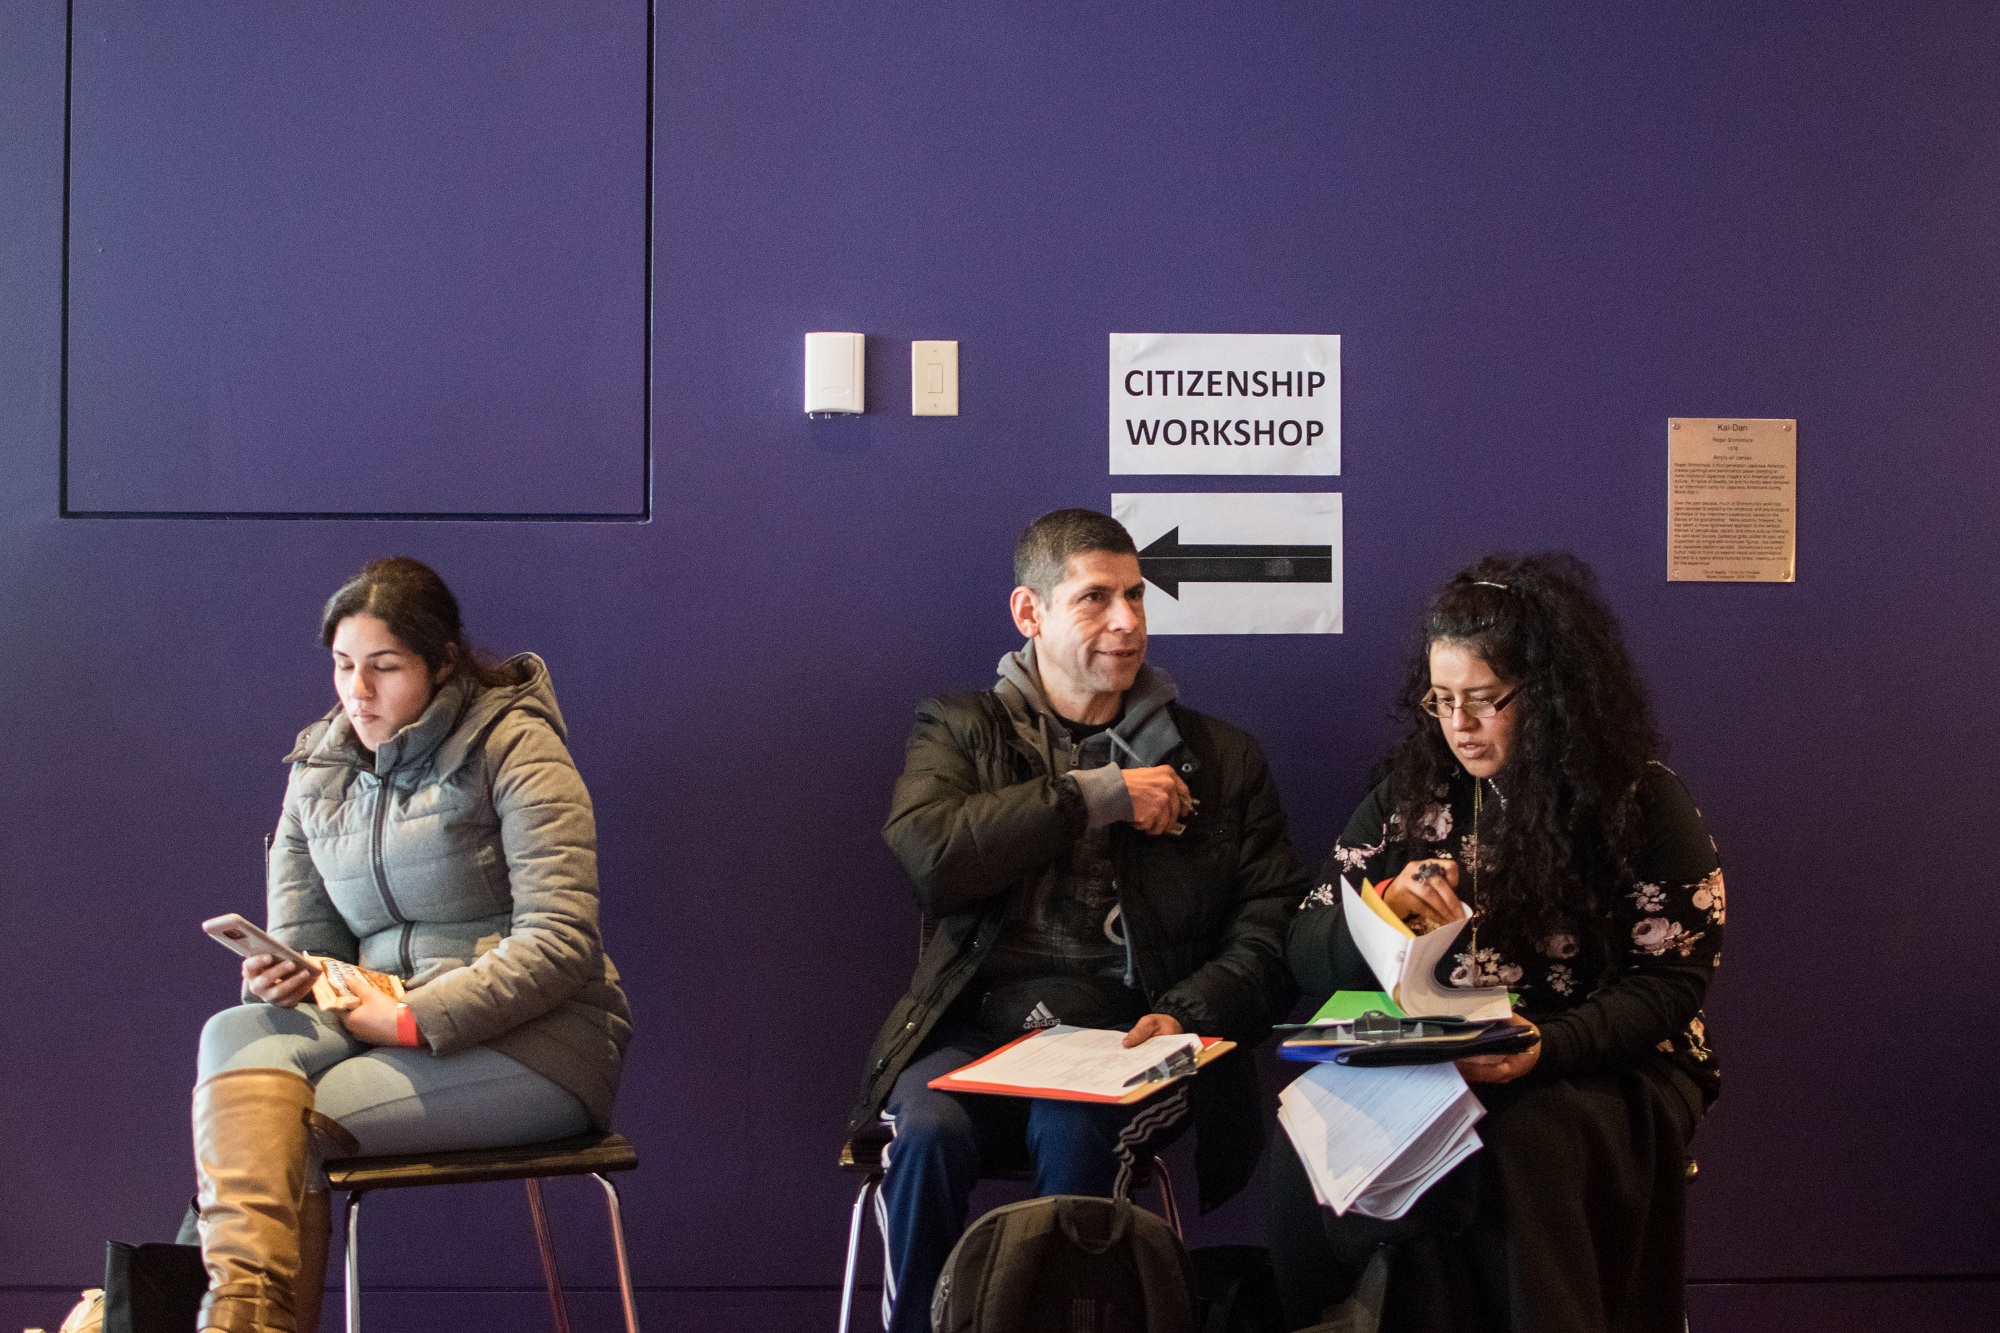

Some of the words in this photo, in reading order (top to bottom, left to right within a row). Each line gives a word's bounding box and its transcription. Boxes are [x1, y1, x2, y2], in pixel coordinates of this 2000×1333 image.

[1124, 369, 1326, 398] CITIZENSHIP
[1125, 419, 1324, 446] WORKSHOP
[1023, 1018, 1061, 1029] adidas
